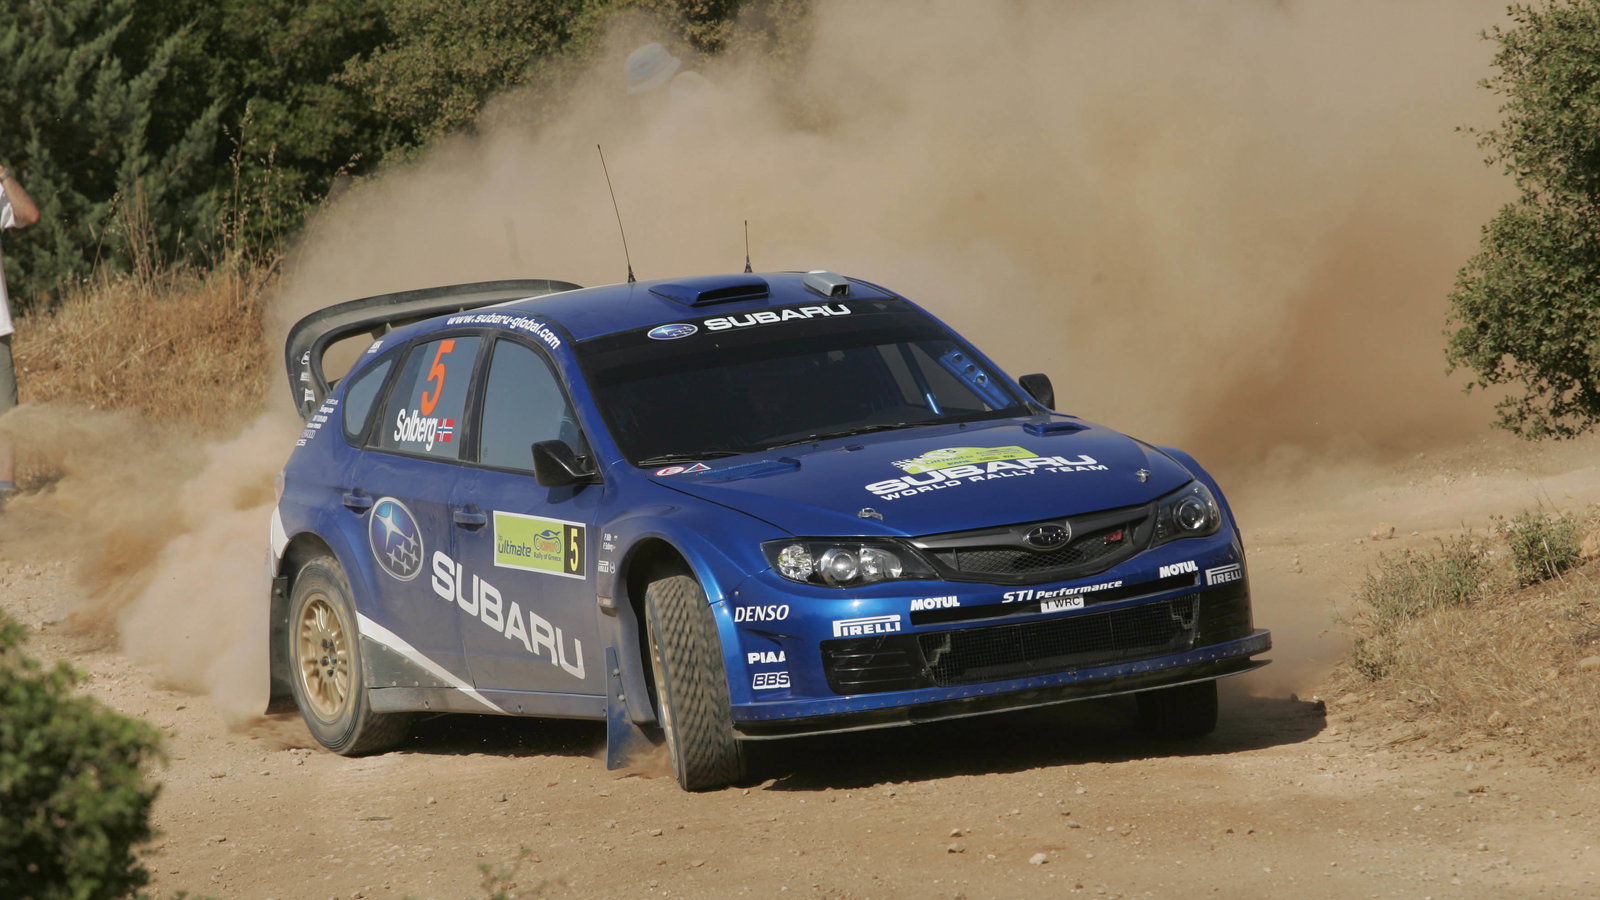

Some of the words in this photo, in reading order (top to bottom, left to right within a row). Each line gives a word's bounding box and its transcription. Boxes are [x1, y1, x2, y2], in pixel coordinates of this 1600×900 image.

[703, 304, 851, 331] SUBARU
[421, 339, 456, 416] 5
[394, 408, 439, 451] Solberg
[865, 454, 1098, 495] SUBARU
[881, 479, 962, 501] WORLD
[971, 468, 1038, 483] RALLY
[1044, 464, 1109, 473] TEAM
[570, 528, 579, 572] 5
[1159, 560, 1198, 578] MOTUL
[1205, 563, 1242, 586] PIRELLI
[910, 595, 960, 611] MOTUL
[1001, 589, 1033, 604] STI
[1036, 580, 1123, 600] Performance
[1054, 596, 1081, 608] WRC
[431, 550, 585, 680] SUBARU
[733, 604, 790, 623] DENSO
[832, 614, 901, 637] PIRELLI
[747, 650, 786, 664] PIAA
[752, 671, 791, 690] BBS
